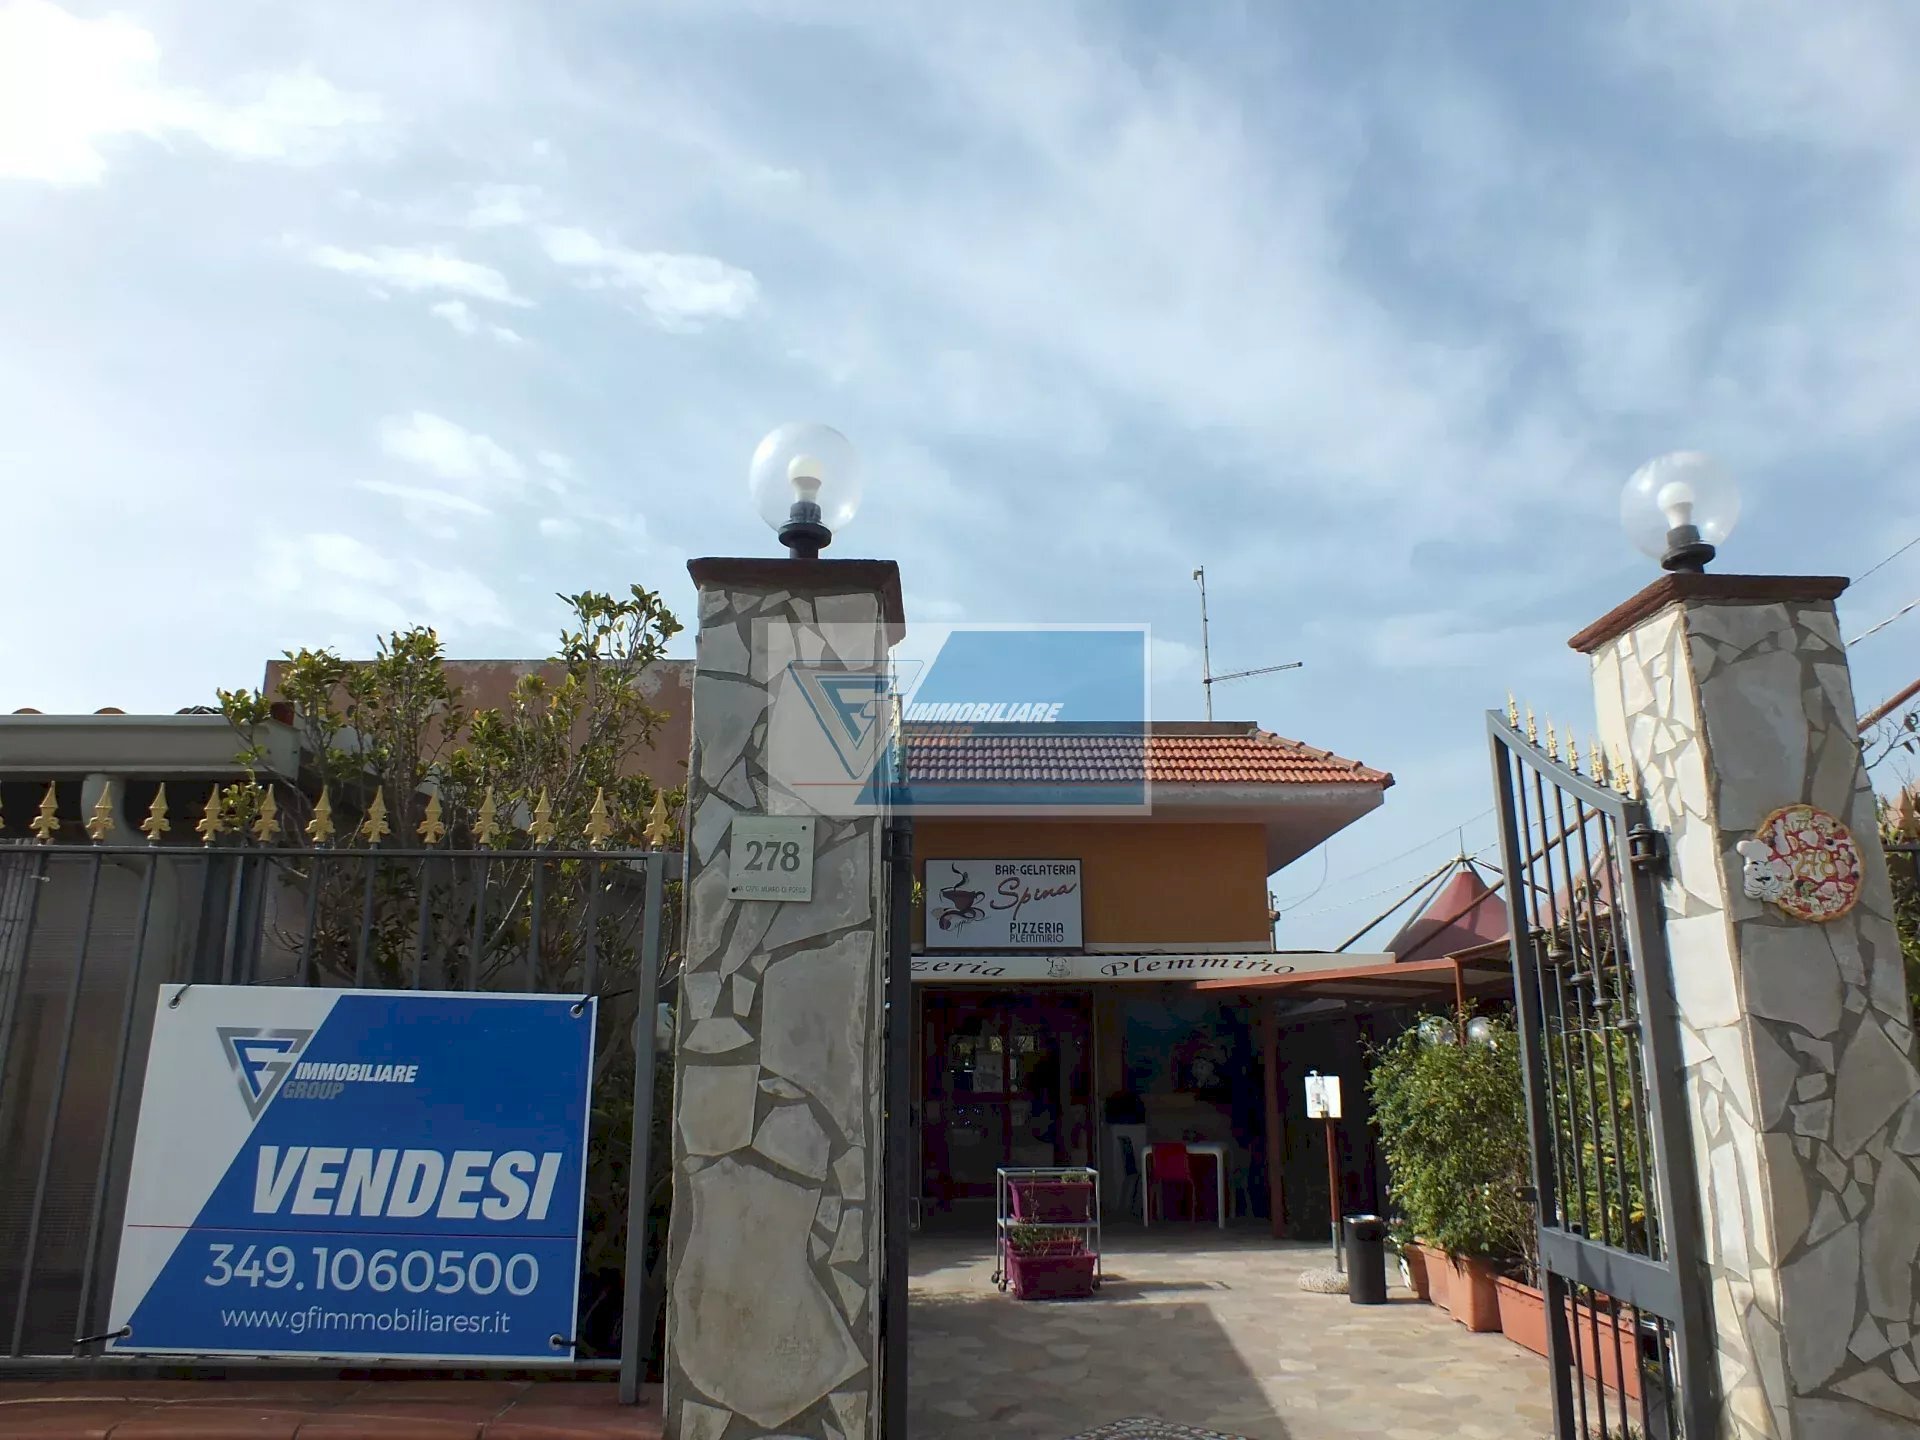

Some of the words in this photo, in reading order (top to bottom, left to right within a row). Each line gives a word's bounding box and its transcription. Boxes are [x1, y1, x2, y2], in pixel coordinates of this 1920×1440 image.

[744, 840, 800, 872] 278
[995, 864, 1076, 875] BAR-GELATERIA
[1009, 922, 1064, 934] PIZZERIA
[1009, 933, 1064, 943] PLEMMIRIO
[1100, 956, 1295, 977] Plemmirio
[295, 1062, 419, 1083] IMMOBILIARE
[283, 1081, 345, 1100] GROUP
[252, 1145, 563, 1221] VENDESI
[204, 1243, 540, 1296] 349.1060500
[221, 1305, 511, 1336] www.gfimmobiliaresr.it
